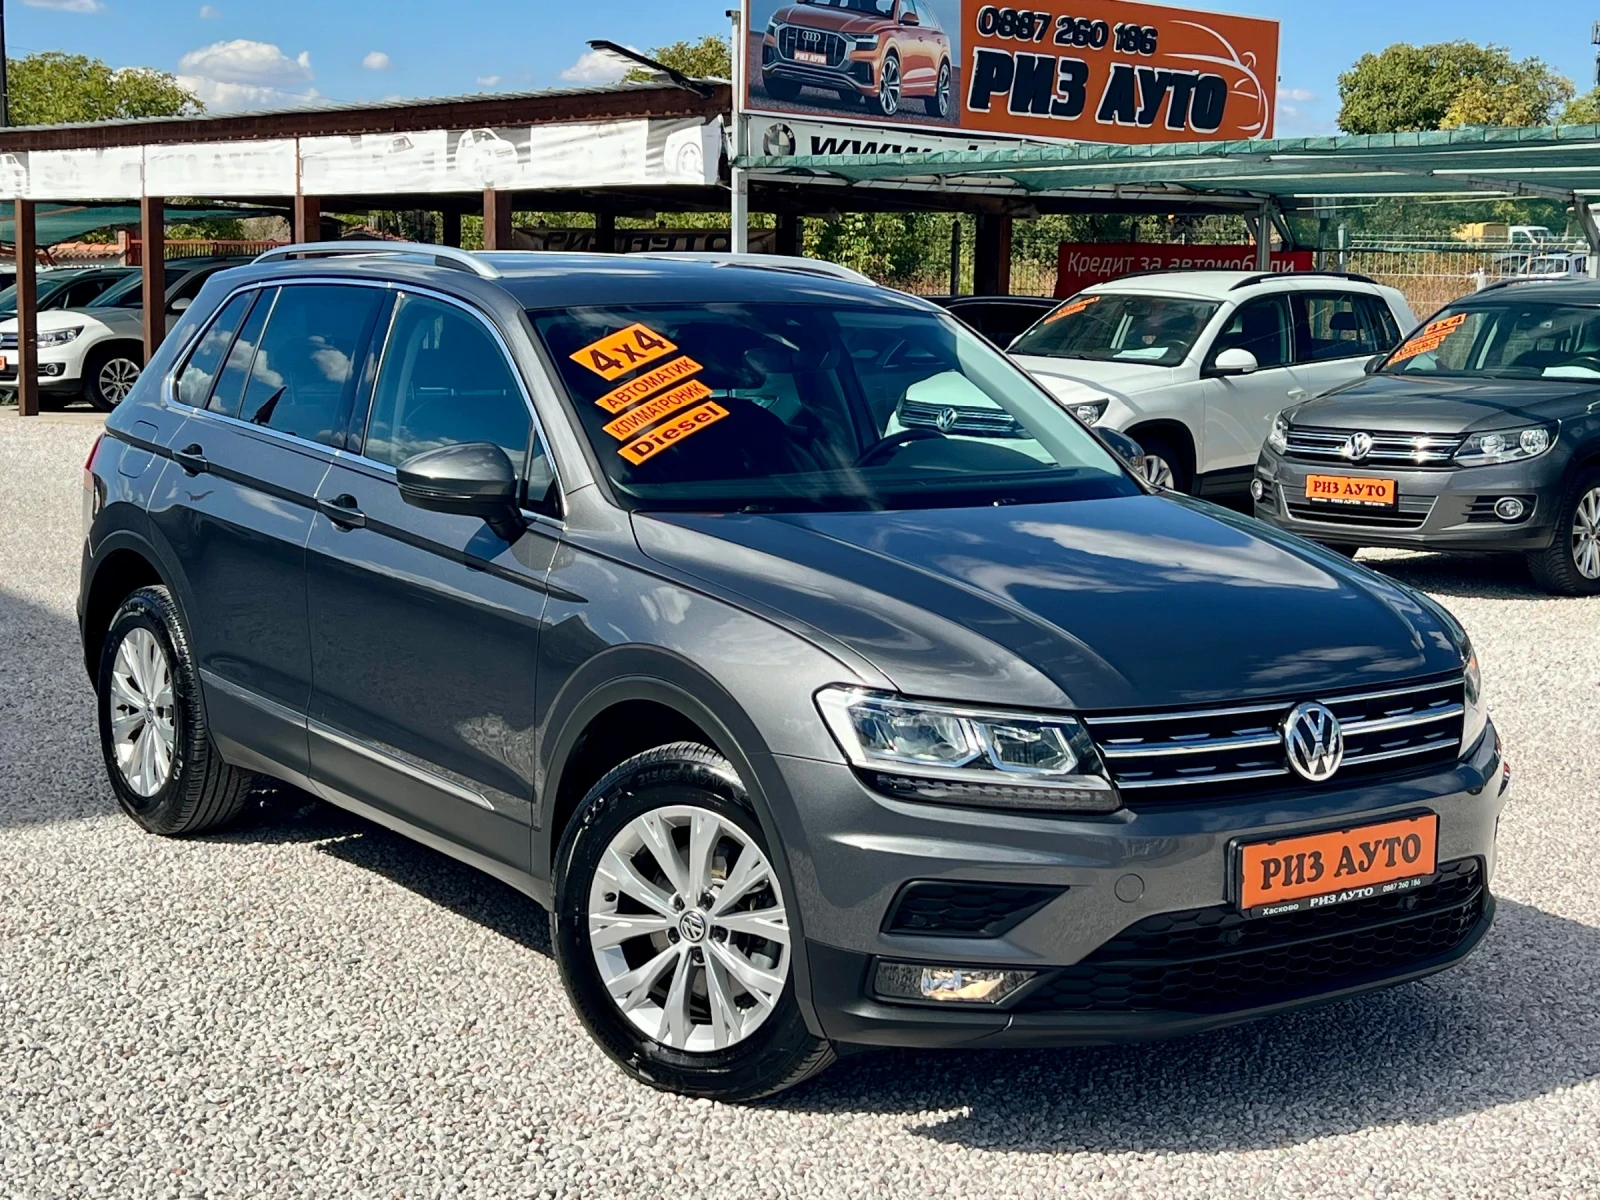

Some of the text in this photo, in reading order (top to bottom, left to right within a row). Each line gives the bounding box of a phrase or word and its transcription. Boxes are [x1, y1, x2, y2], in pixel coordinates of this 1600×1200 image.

[976, 5, 1158, 55] 0887 260 186
[967, 46, 1228, 133] РИЗ АУТО
[1067, 252, 1135, 277] Кредит
[1140, 256, 1161, 269] за
[606, 359, 697, 409] АВТОМАТИК
[611, 383, 706, 436] КЛИМАТРОНИК
[629, 405, 721, 457] Diesel
[1313, 480, 1386, 497] РИЗ АУТО
[1260, 833, 1422, 890] РИЗ АУТО
[1262, 903, 1299, 916] Хасково
[1309, 887, 1374, 907] РИЗ АУТО
